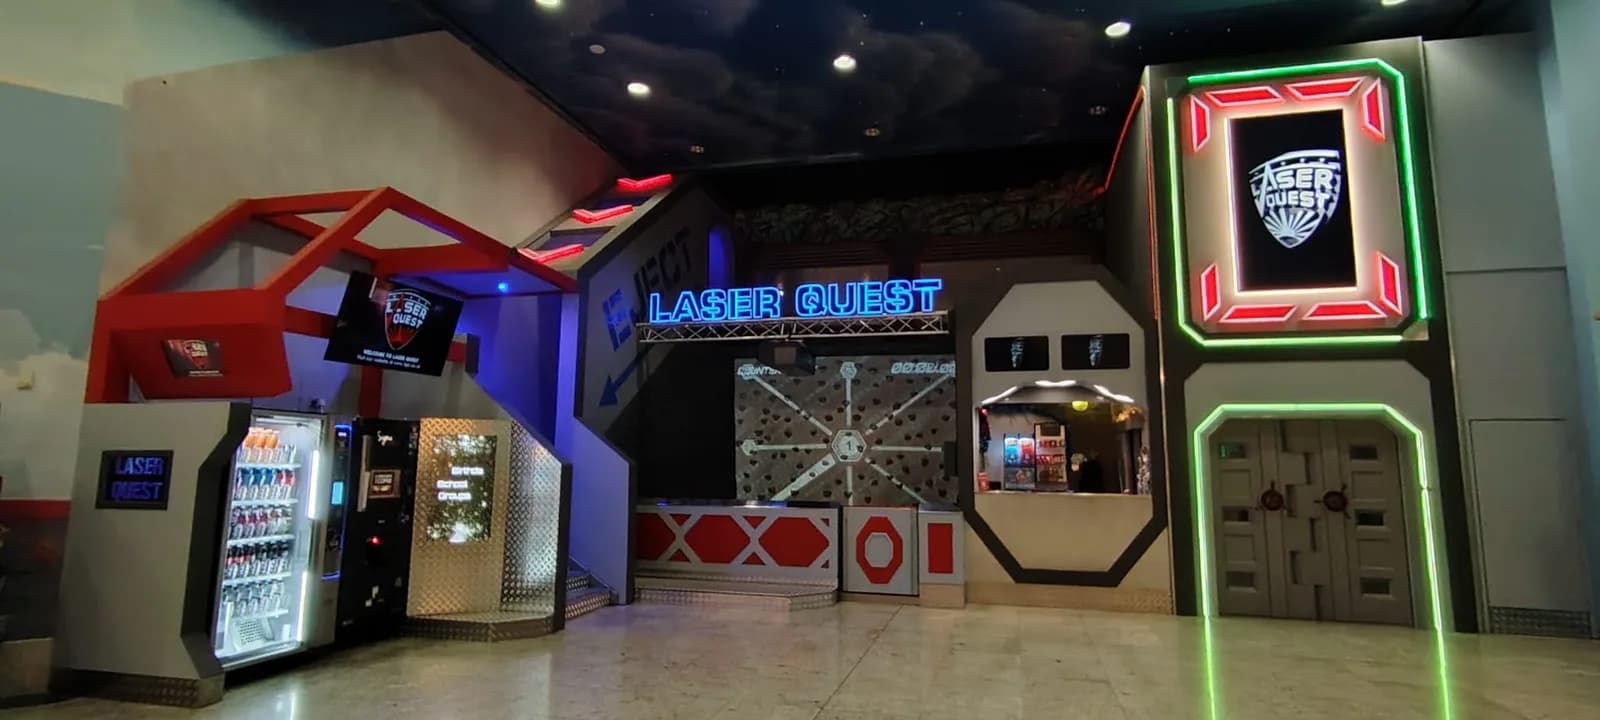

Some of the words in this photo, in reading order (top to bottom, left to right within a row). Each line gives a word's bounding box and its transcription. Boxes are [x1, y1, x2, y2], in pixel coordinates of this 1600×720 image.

[1250, 165, 1333, 200] LASER
[1265, 190, 1330, 212] QUEST
[602, 226, 691, 352] EJECT
[385, 296, 428, 320] LASER
[649, 287, 781, 325] LASER
[795, 278, 943, 318] QUEST
[392, 312, 424, 329] QUEST
[114, 456, 164, 475] LASER
[111, 481, 164, 501] QUEST
